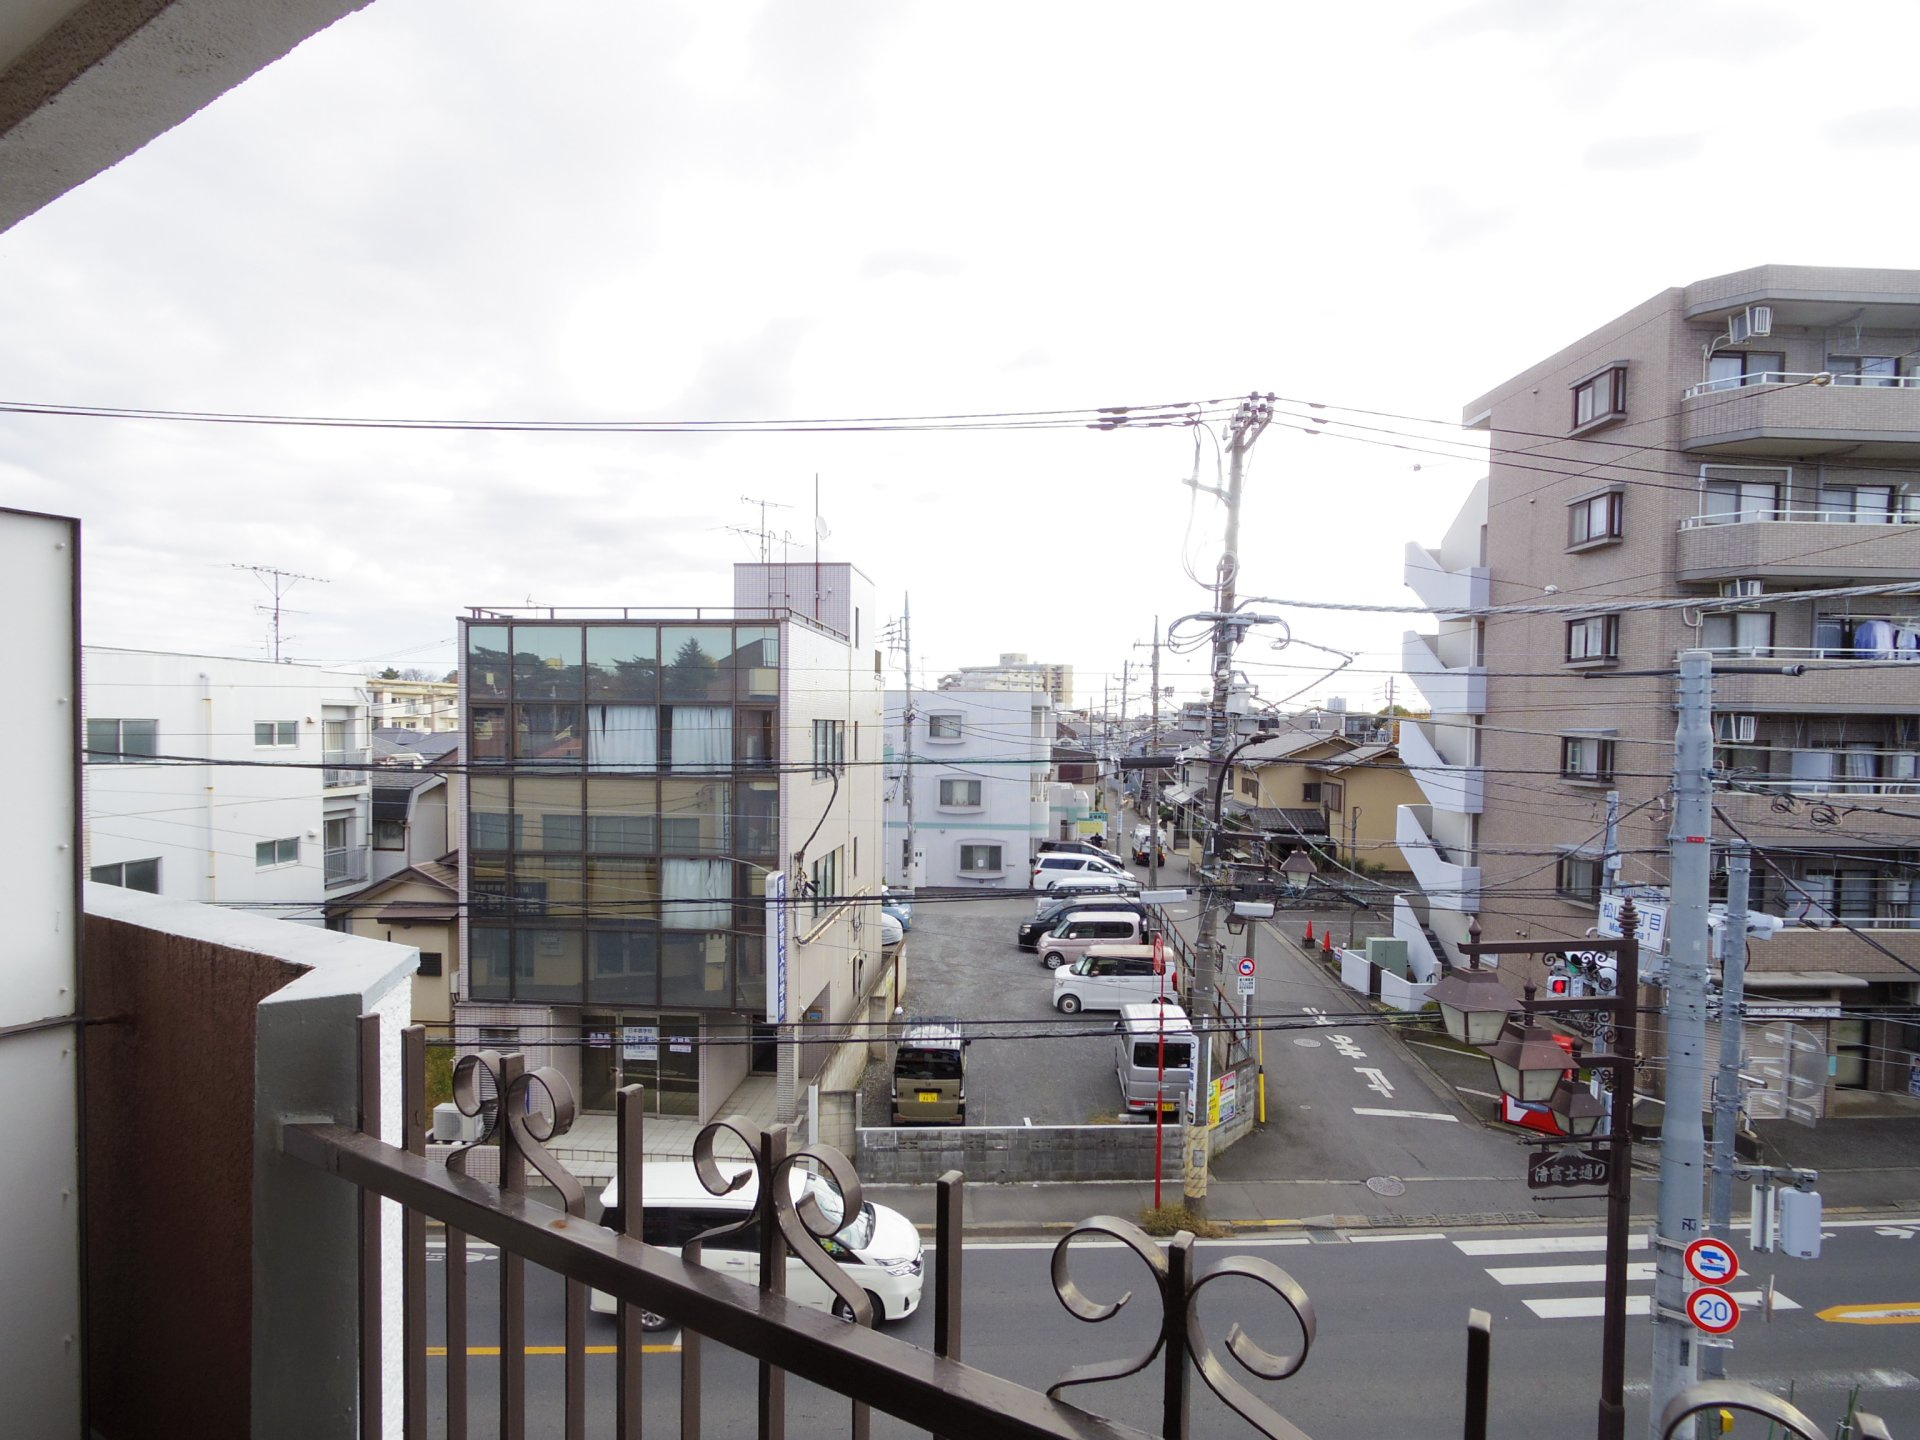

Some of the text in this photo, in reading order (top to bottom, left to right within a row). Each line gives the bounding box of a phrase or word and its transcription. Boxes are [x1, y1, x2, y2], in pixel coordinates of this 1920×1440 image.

[1603, 901, 1661, 931] 松山丁目
[1699, 1300, 1728, 1321] 20
